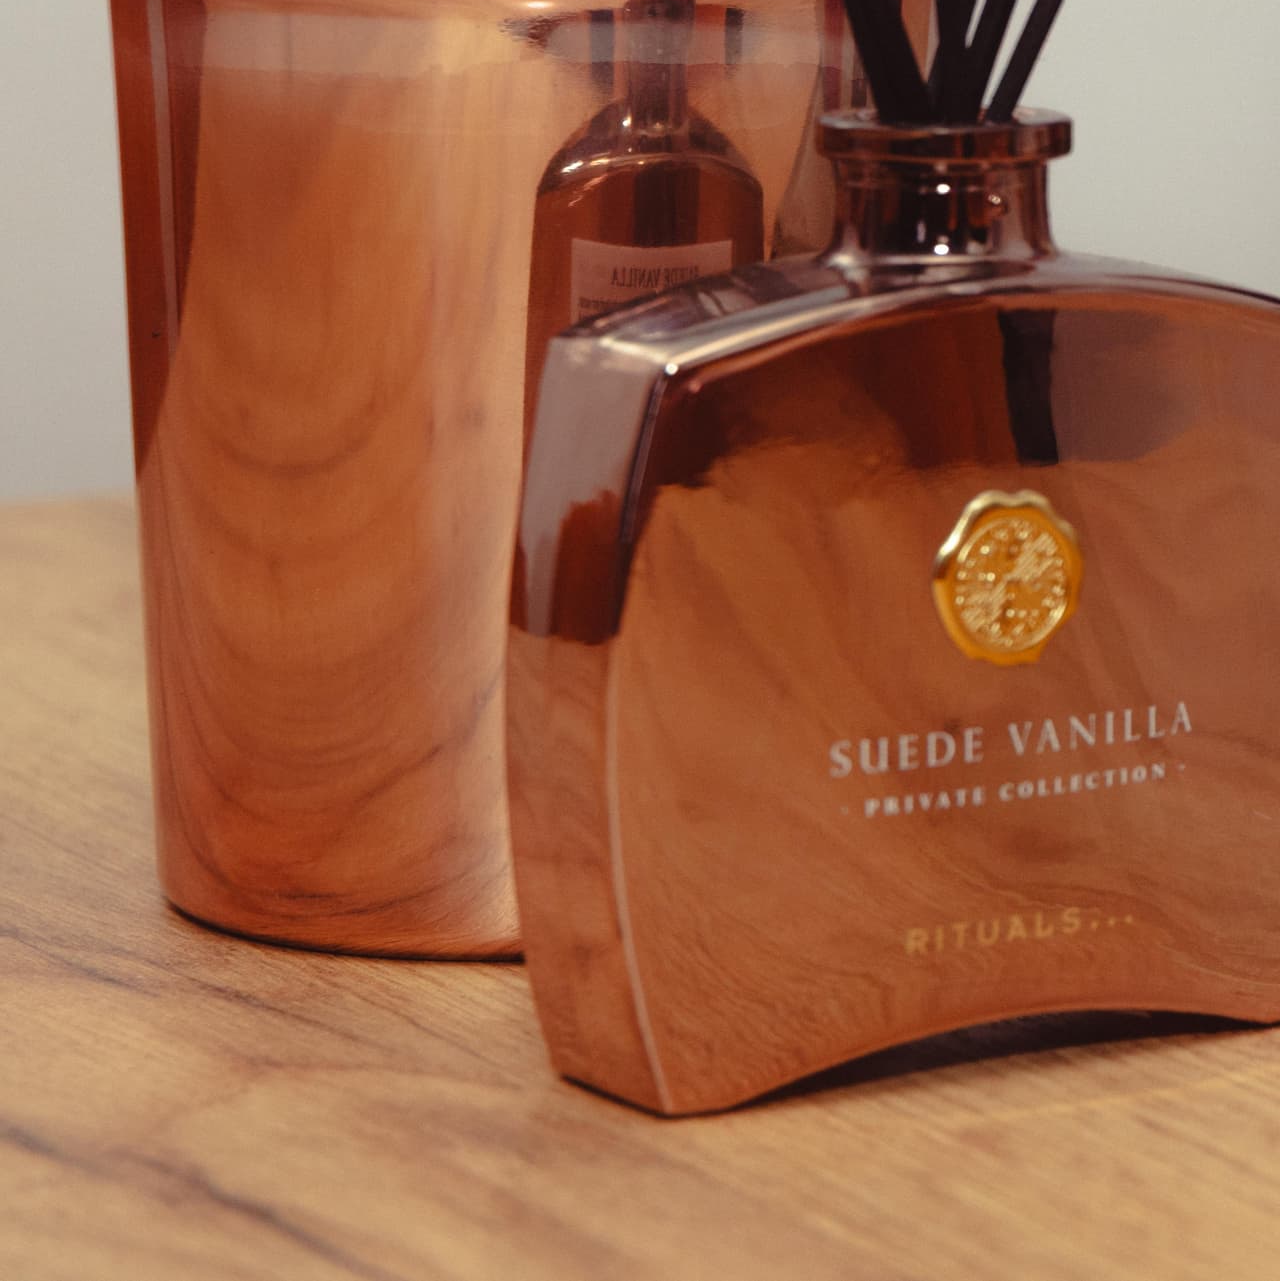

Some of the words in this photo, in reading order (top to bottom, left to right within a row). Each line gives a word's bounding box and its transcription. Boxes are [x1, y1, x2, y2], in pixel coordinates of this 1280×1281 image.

[828, 726, 984, 778] SUEDE
[1008, 701, 1193, 757] VANILLA
[863, 786, 985, 818] PRIVATE
[998, 762, 1166, 802] COLLECTION
